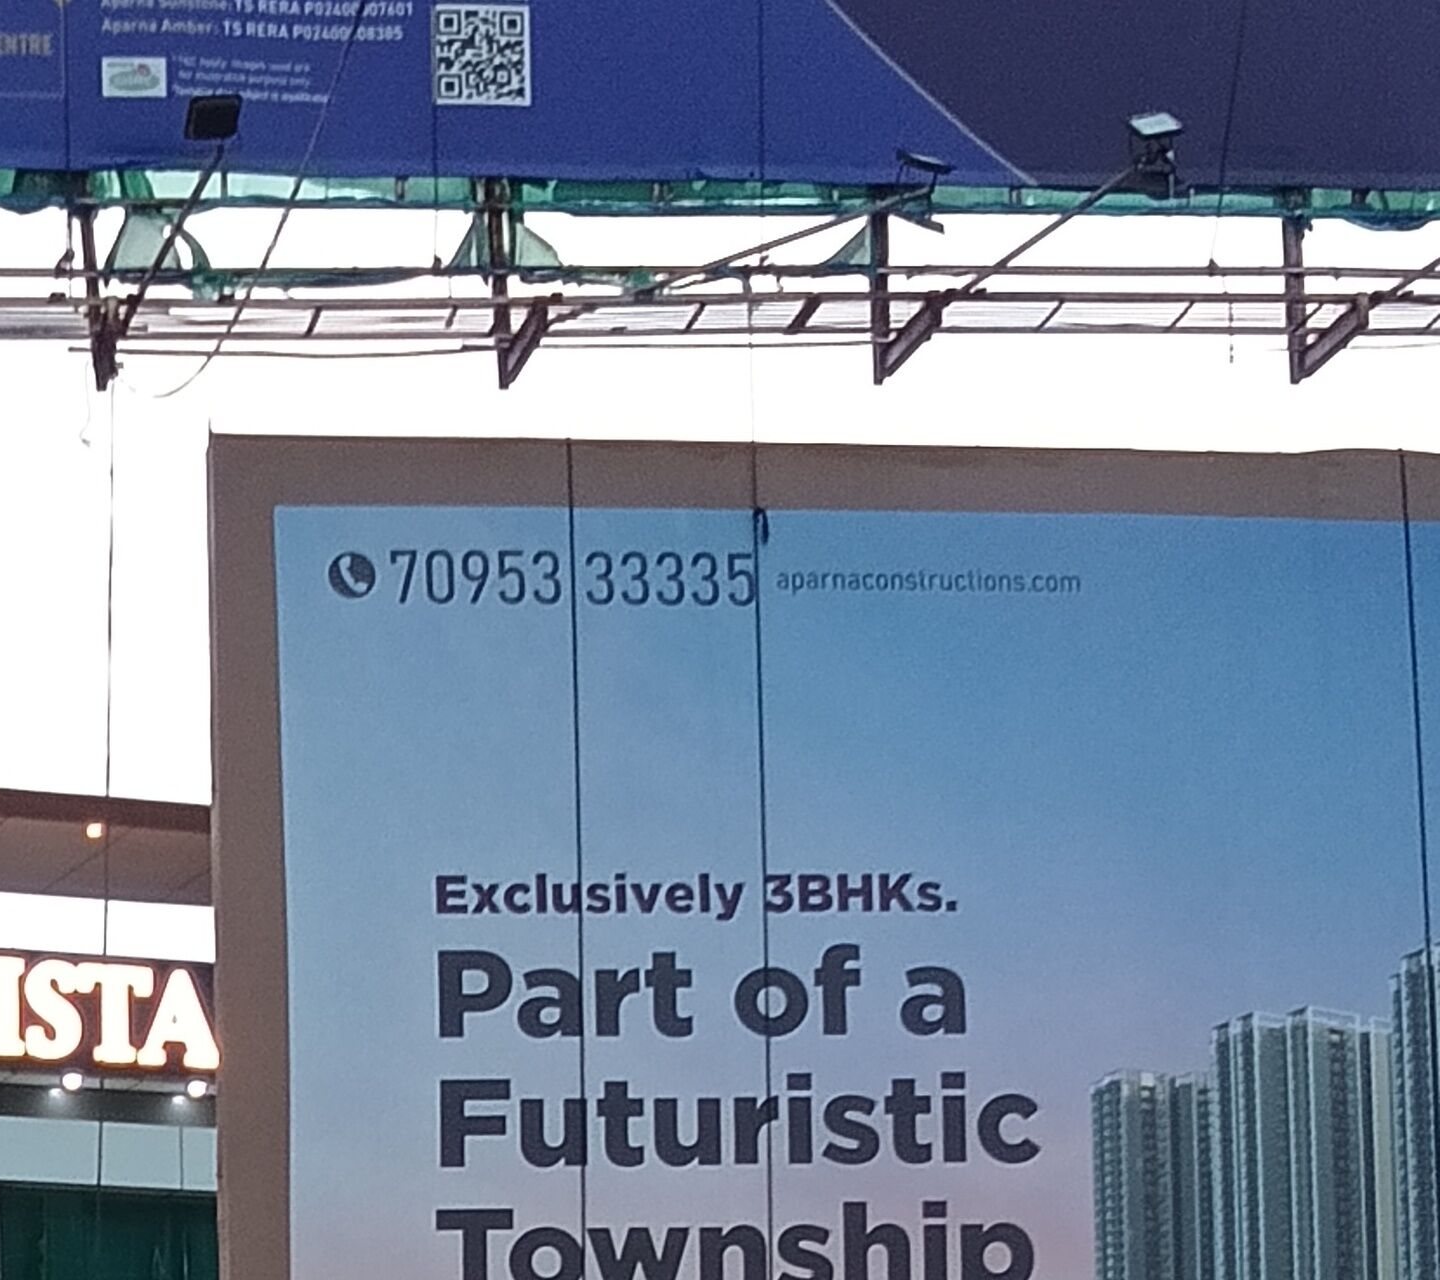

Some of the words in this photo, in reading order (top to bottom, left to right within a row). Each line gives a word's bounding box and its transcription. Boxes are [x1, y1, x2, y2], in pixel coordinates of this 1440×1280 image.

[246, 22, 288, 39] RERA
[390, 550, 562, 604] 70953
[584, 551, 757, 606] 33335
[777, 569, 1080, 594] aparnaconstructions.com
[435, 873, 745, 921] Exclusively
[765, 873, 958, 912] 3BHKs.
[437, 950, 694, 1038] Part
[734, 943, 862, 1037] of
[900, 965, 967, 1035] a
[440, 1072, 1042, 1168] Futuristic
